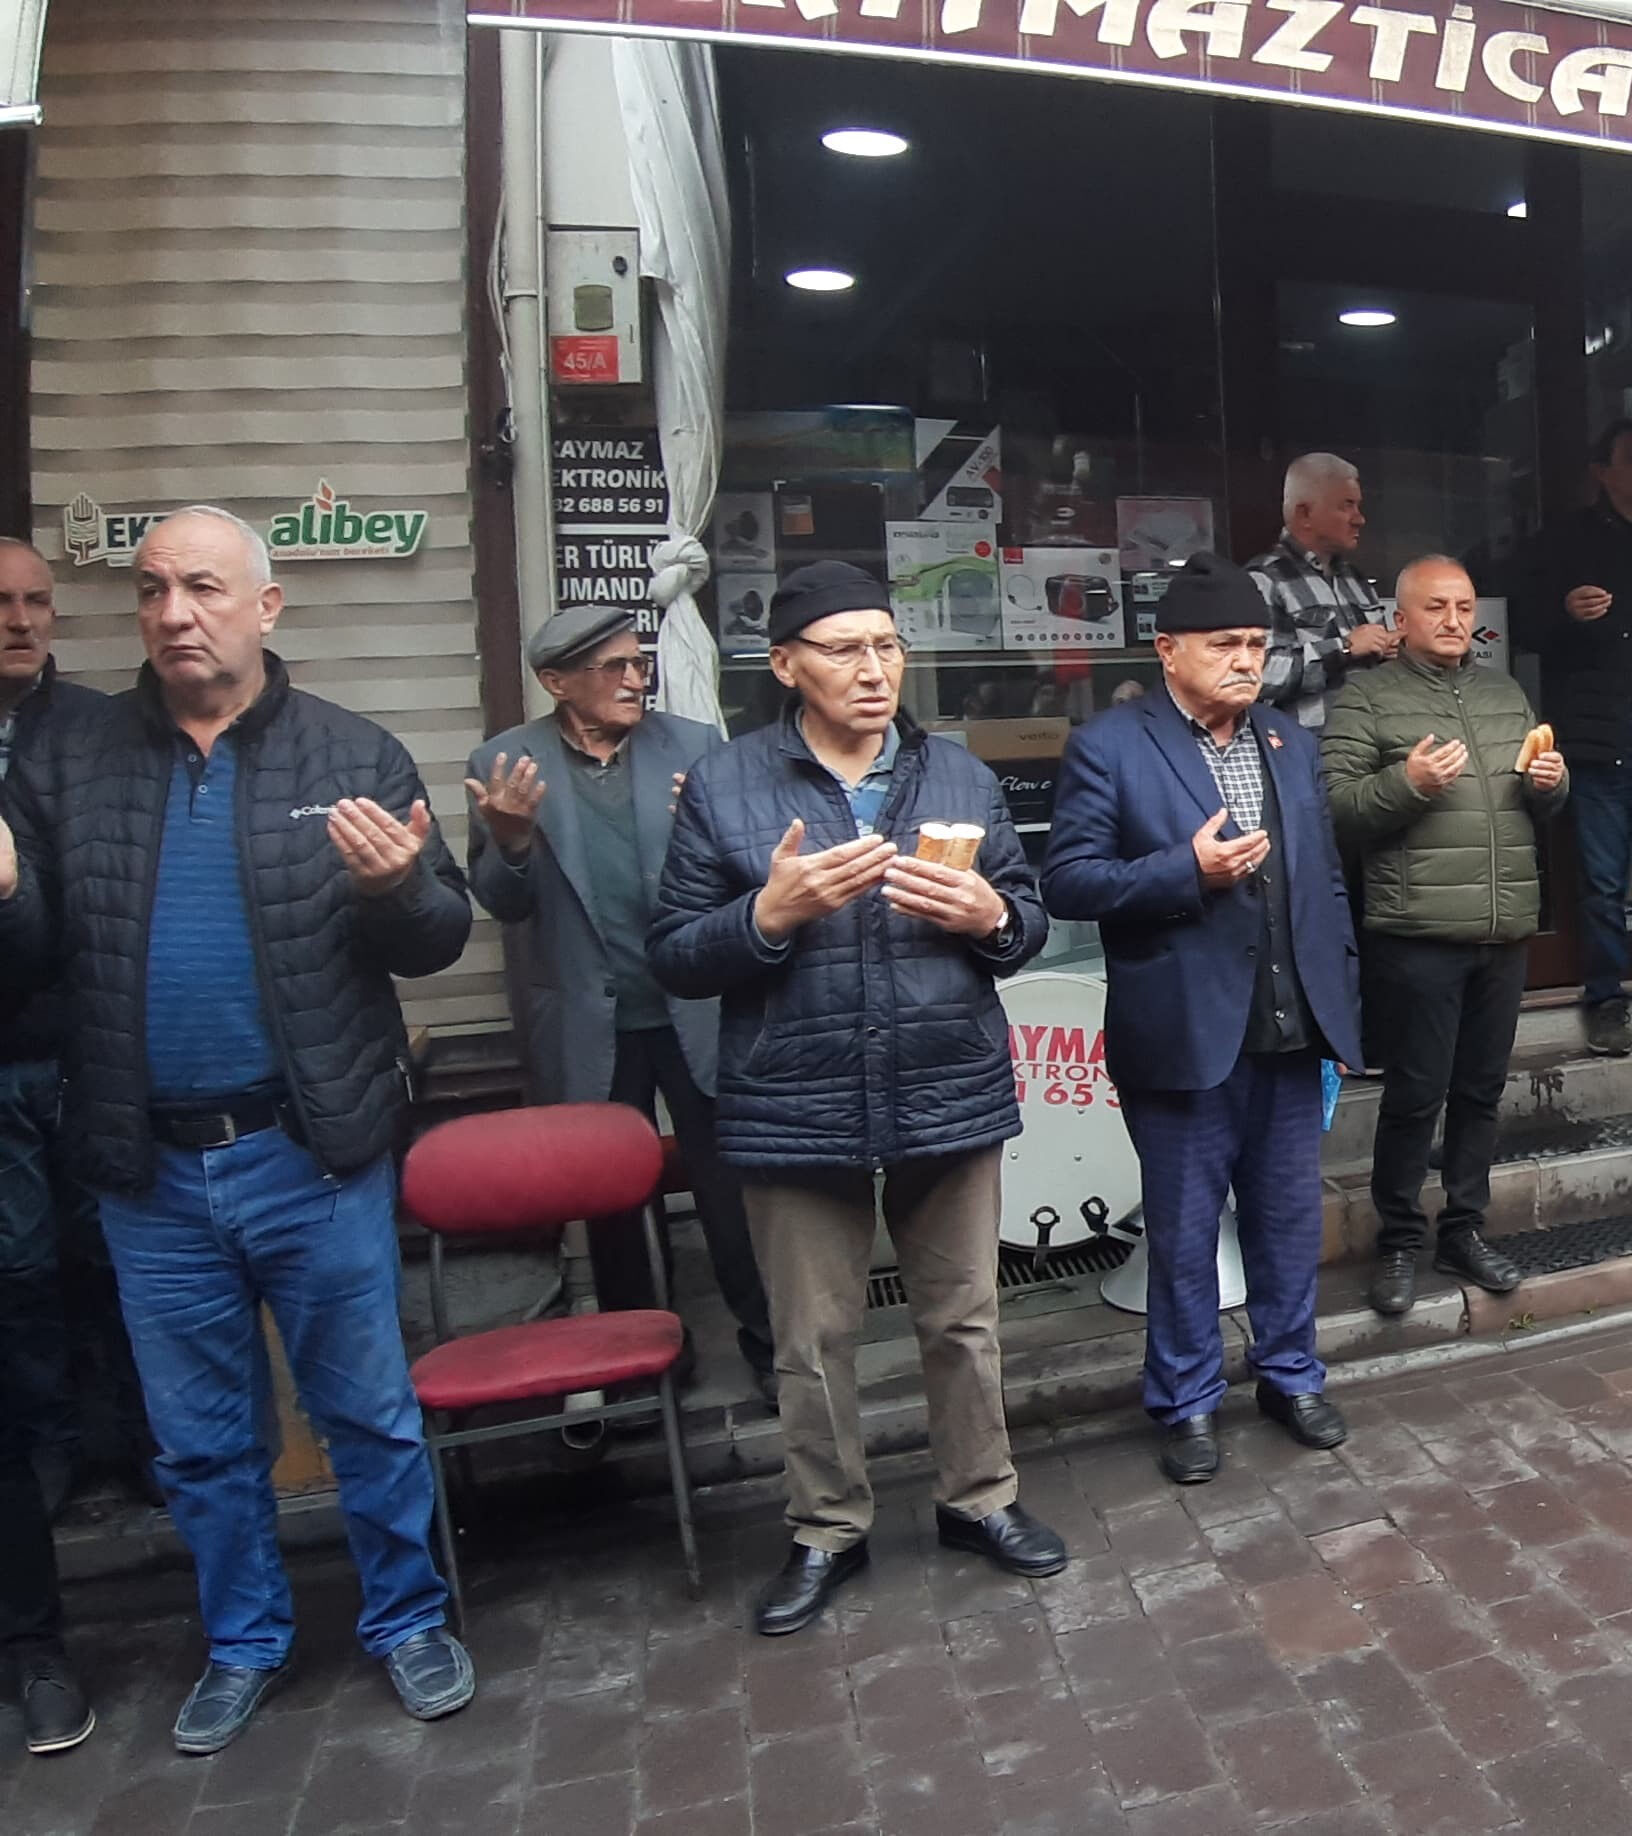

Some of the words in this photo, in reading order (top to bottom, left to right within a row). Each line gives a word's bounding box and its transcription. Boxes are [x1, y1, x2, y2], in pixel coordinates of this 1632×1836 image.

[563, 351, 607, 370] 45/A
[578, 498, 614, 513] 688
[618, 498, 641, 513] 56
[644, 498, 664, 513] 91
[271, 498, 426, 553] alibey
[1043, 1082, 1094, 1107] 65
